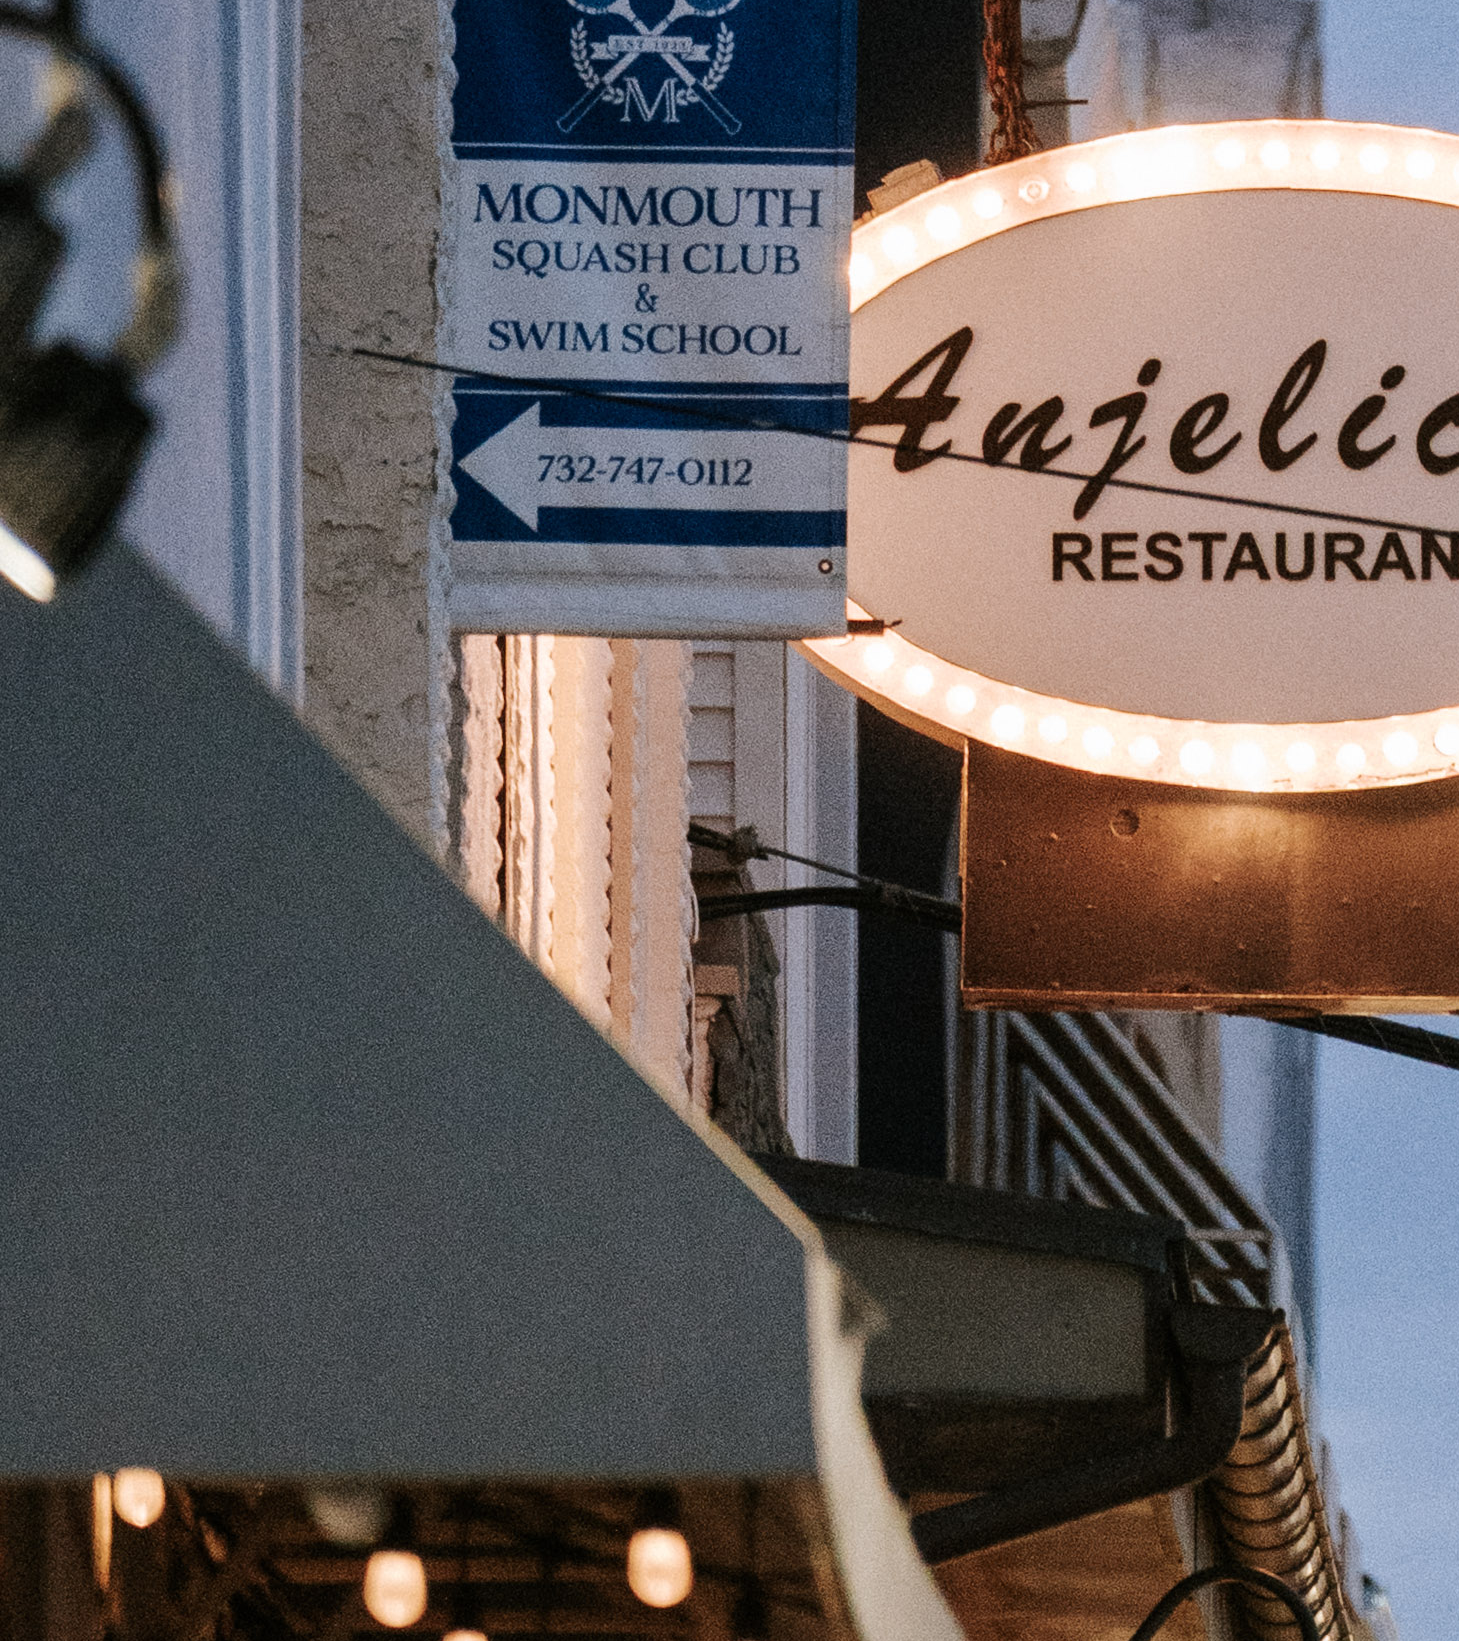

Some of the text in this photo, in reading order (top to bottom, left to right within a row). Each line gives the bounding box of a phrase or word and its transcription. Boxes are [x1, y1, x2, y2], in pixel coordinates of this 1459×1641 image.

[620, 76, 680, 122] M
[473, 182, 823, 228] MONMOUTH
[492, 239, 801, 278] SQUASH CLUB
[634, 282, 658, 313] &
[488, 319, 803, 356] SWIM SCHOOL
[537, 454, 754, 486] 732-747-0112
